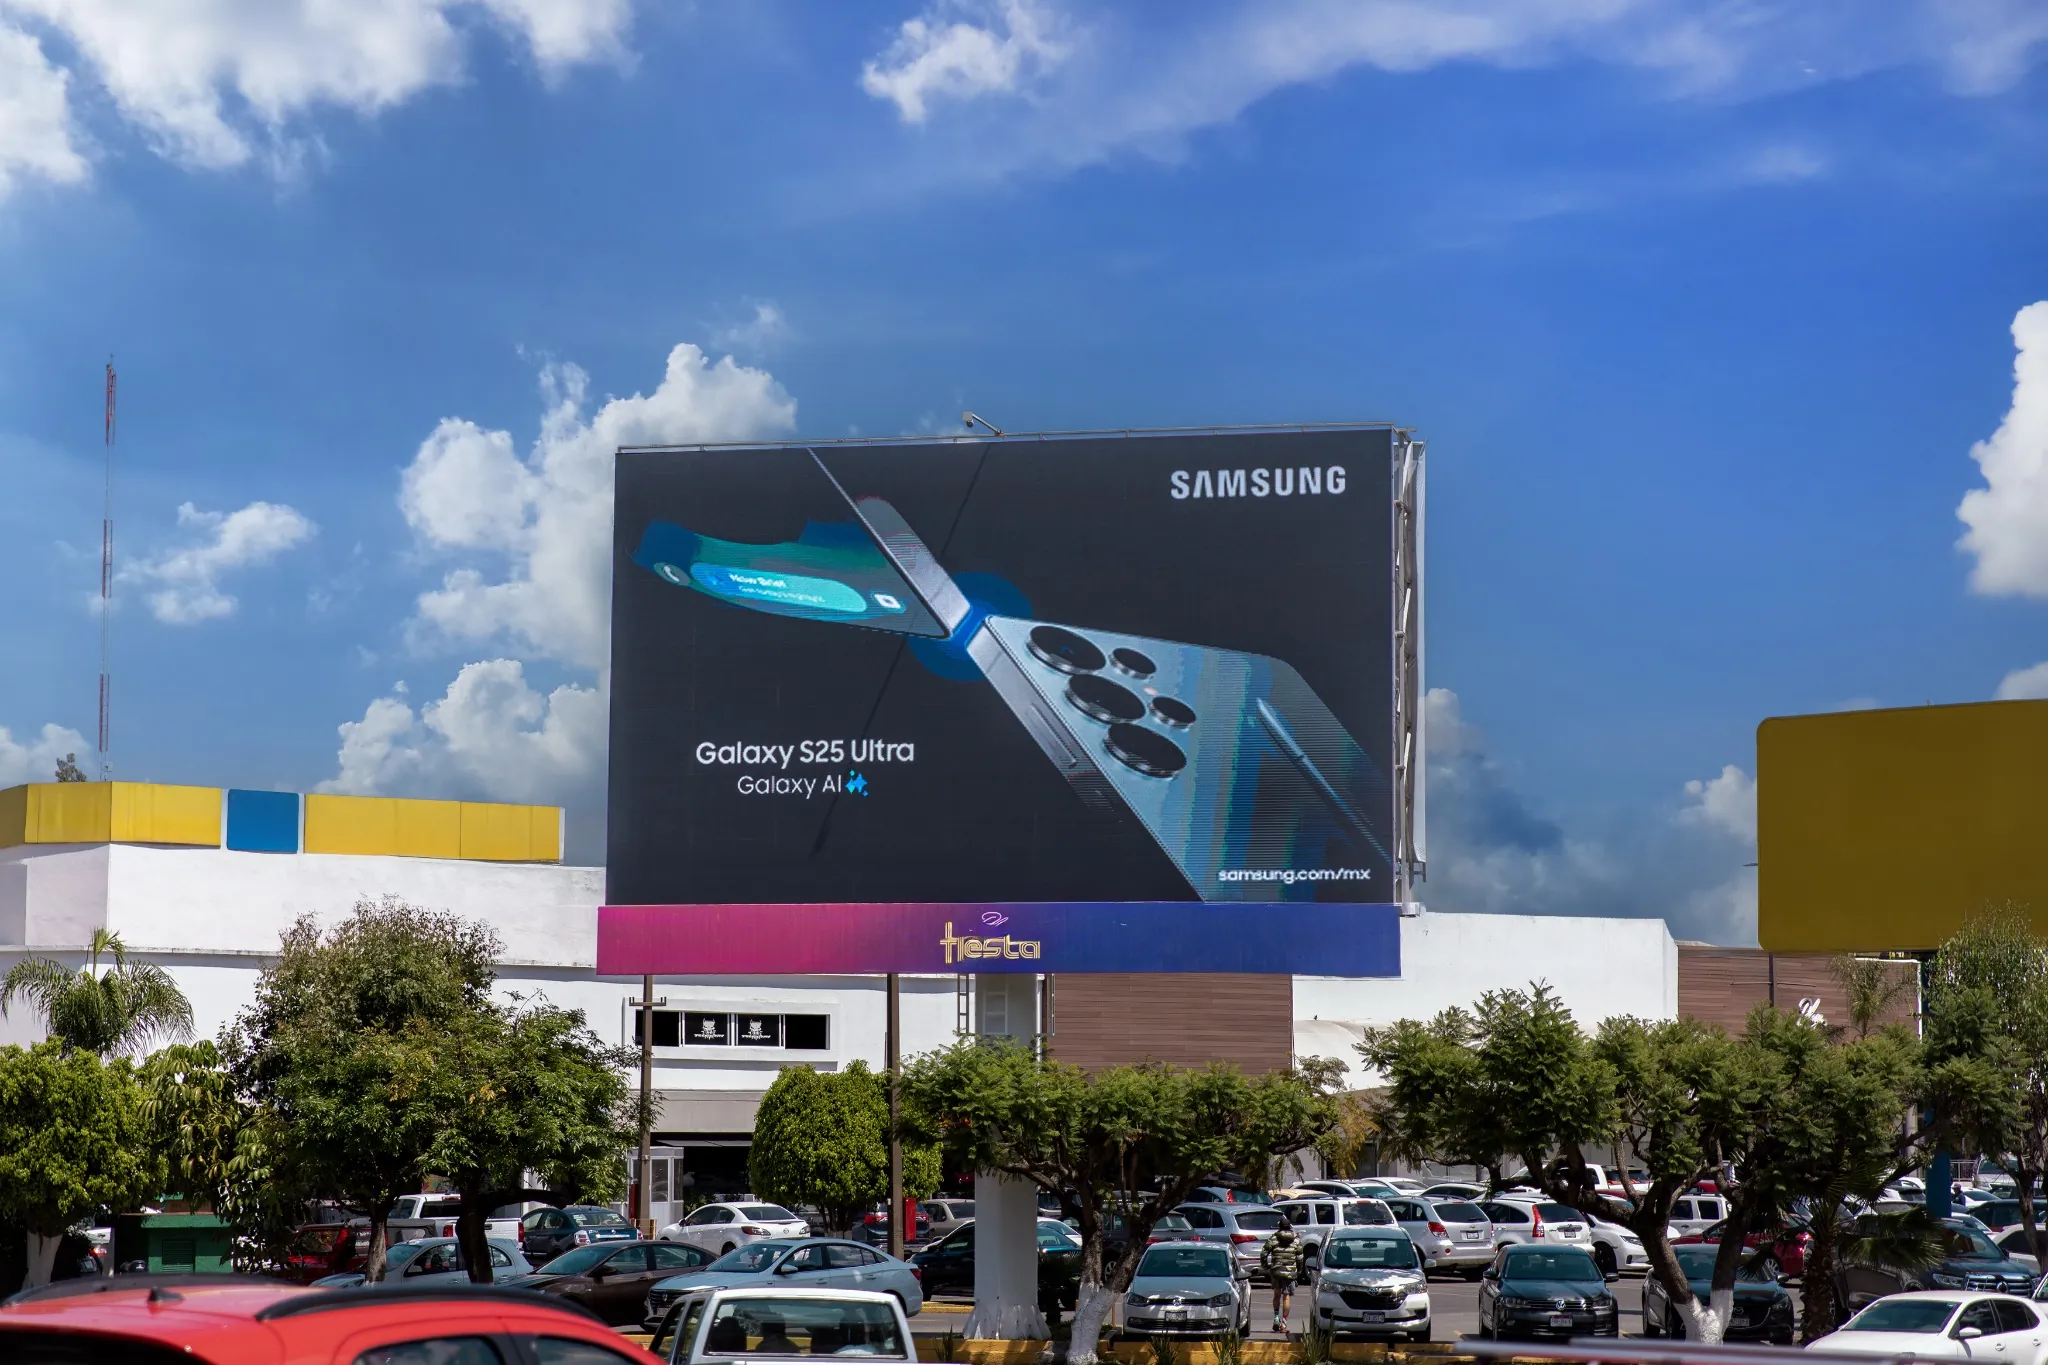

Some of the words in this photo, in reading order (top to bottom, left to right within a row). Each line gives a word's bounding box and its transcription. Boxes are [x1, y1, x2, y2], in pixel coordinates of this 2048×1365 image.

[1171, 466, 1346, 499] SAMSUNG
[696, 741, 795, 770] Galaxy
[799, 740, 845, 764] S25
[851, 739, 915, 763] Ultra
[737, 775, 817, 800] Galaxy
[822, 774, 843, 794] AI
[1218, 867, 1371, 885] samsung.com/mx
